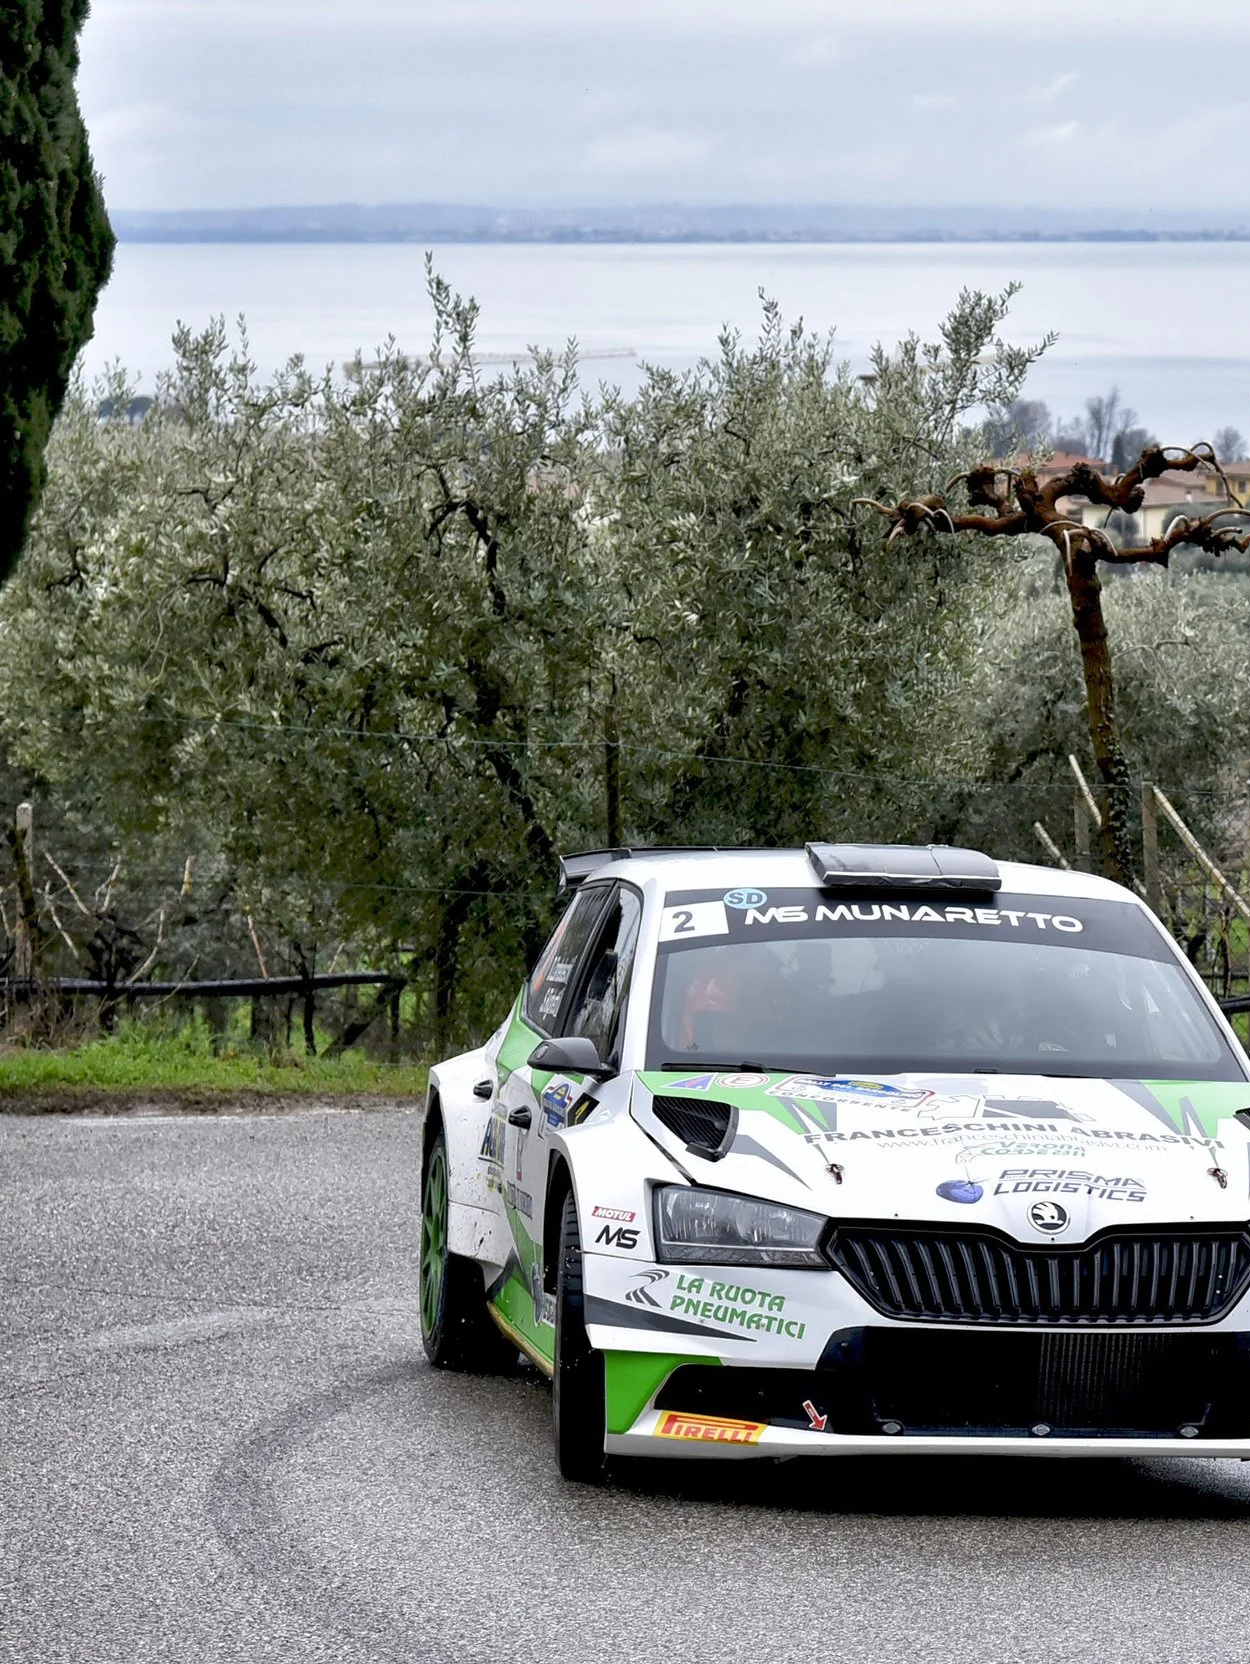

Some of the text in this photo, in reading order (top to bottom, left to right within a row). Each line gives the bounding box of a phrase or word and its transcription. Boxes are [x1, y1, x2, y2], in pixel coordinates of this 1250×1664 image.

[728, 892, 763, 905] SD
[672, 911, 695, 933] 2
[745, 904, 1083, 932] MS MUNARETTO
[768, 1090, 912, 1113] CONCORRENTE
[803, 1123, 1226, 1149] FRANCESCHINI ABRASIVI
[998, 1169, 1146, 1188] PRISMA
[993, 1182, 1148, 1202] LOGISTICS
[595, 1208, 635, 1221] MOTUL
[595, 1225, 641, 1249] MS
[676, 1275, 786, 1312] LA RUOTA
[669, 1294, 806, 1340] PNEUMATICI
[661, 1414, 760, 1444] PIRELLI
